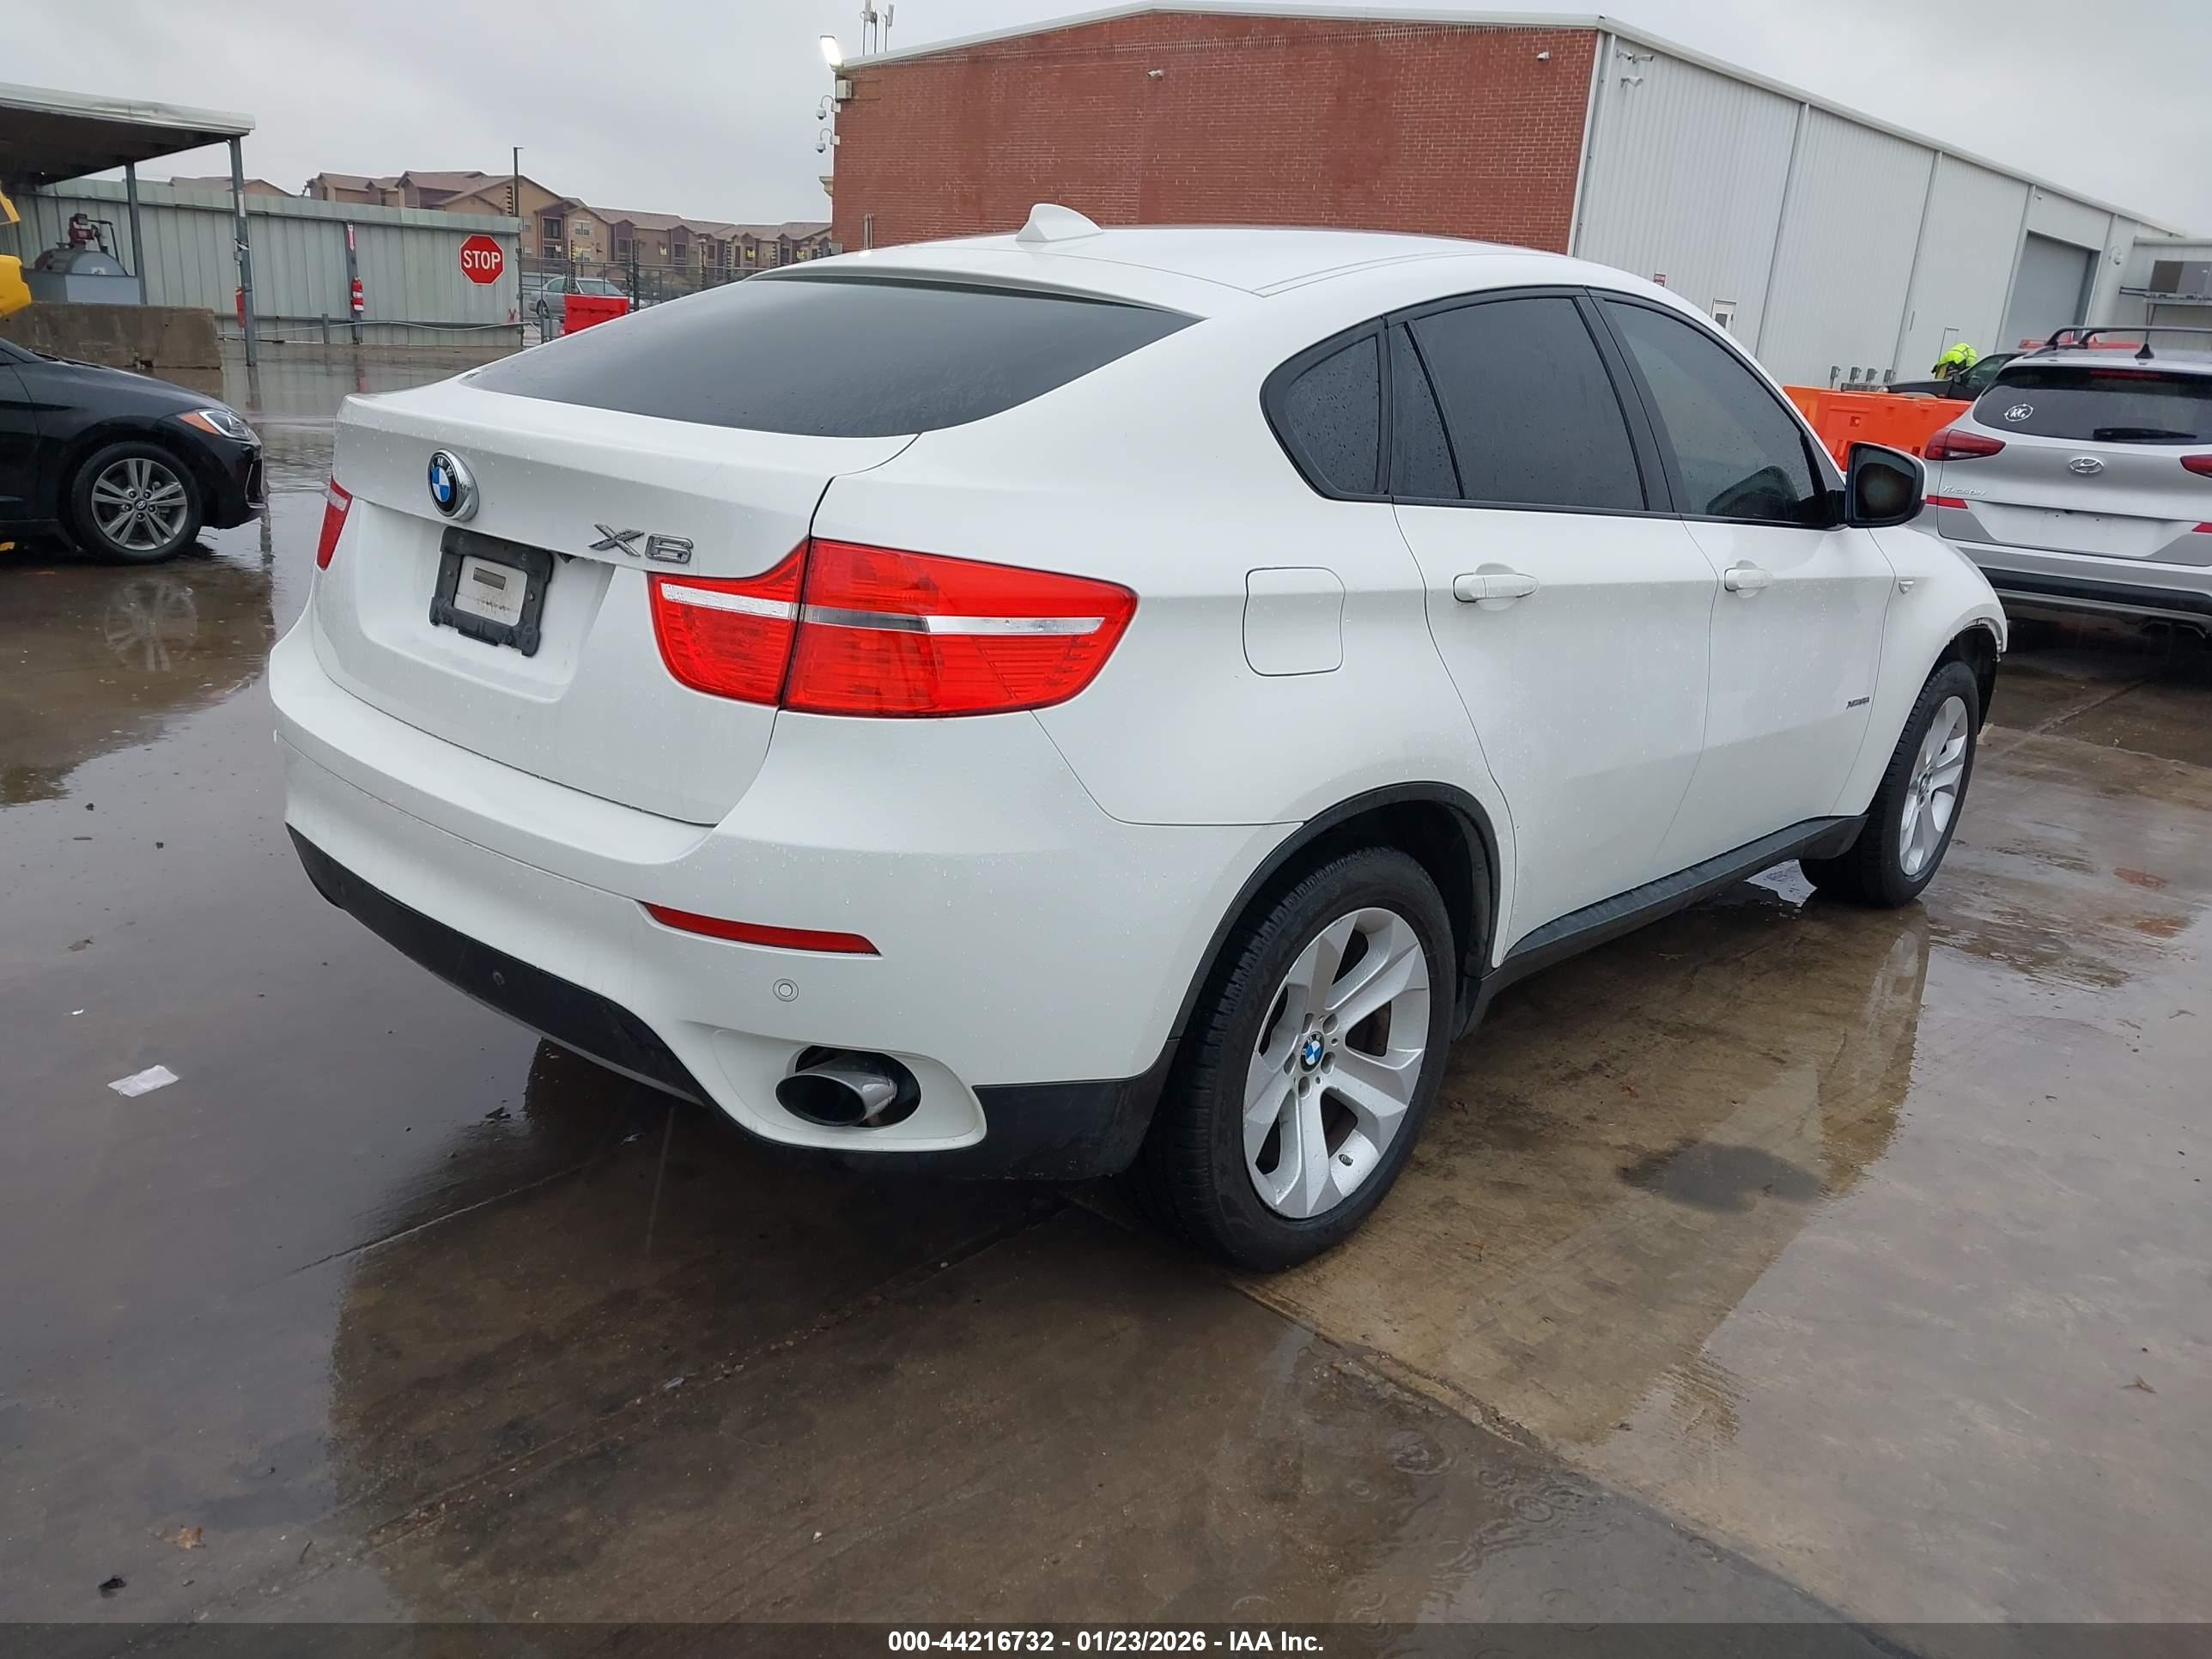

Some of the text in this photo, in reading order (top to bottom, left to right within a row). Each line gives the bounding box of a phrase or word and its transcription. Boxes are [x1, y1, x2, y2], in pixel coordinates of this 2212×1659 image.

[463, 250, 501, 270] STOP
[1943, 486, 1986, 496] TUCSON
[587, 522, 695, 564] X6
